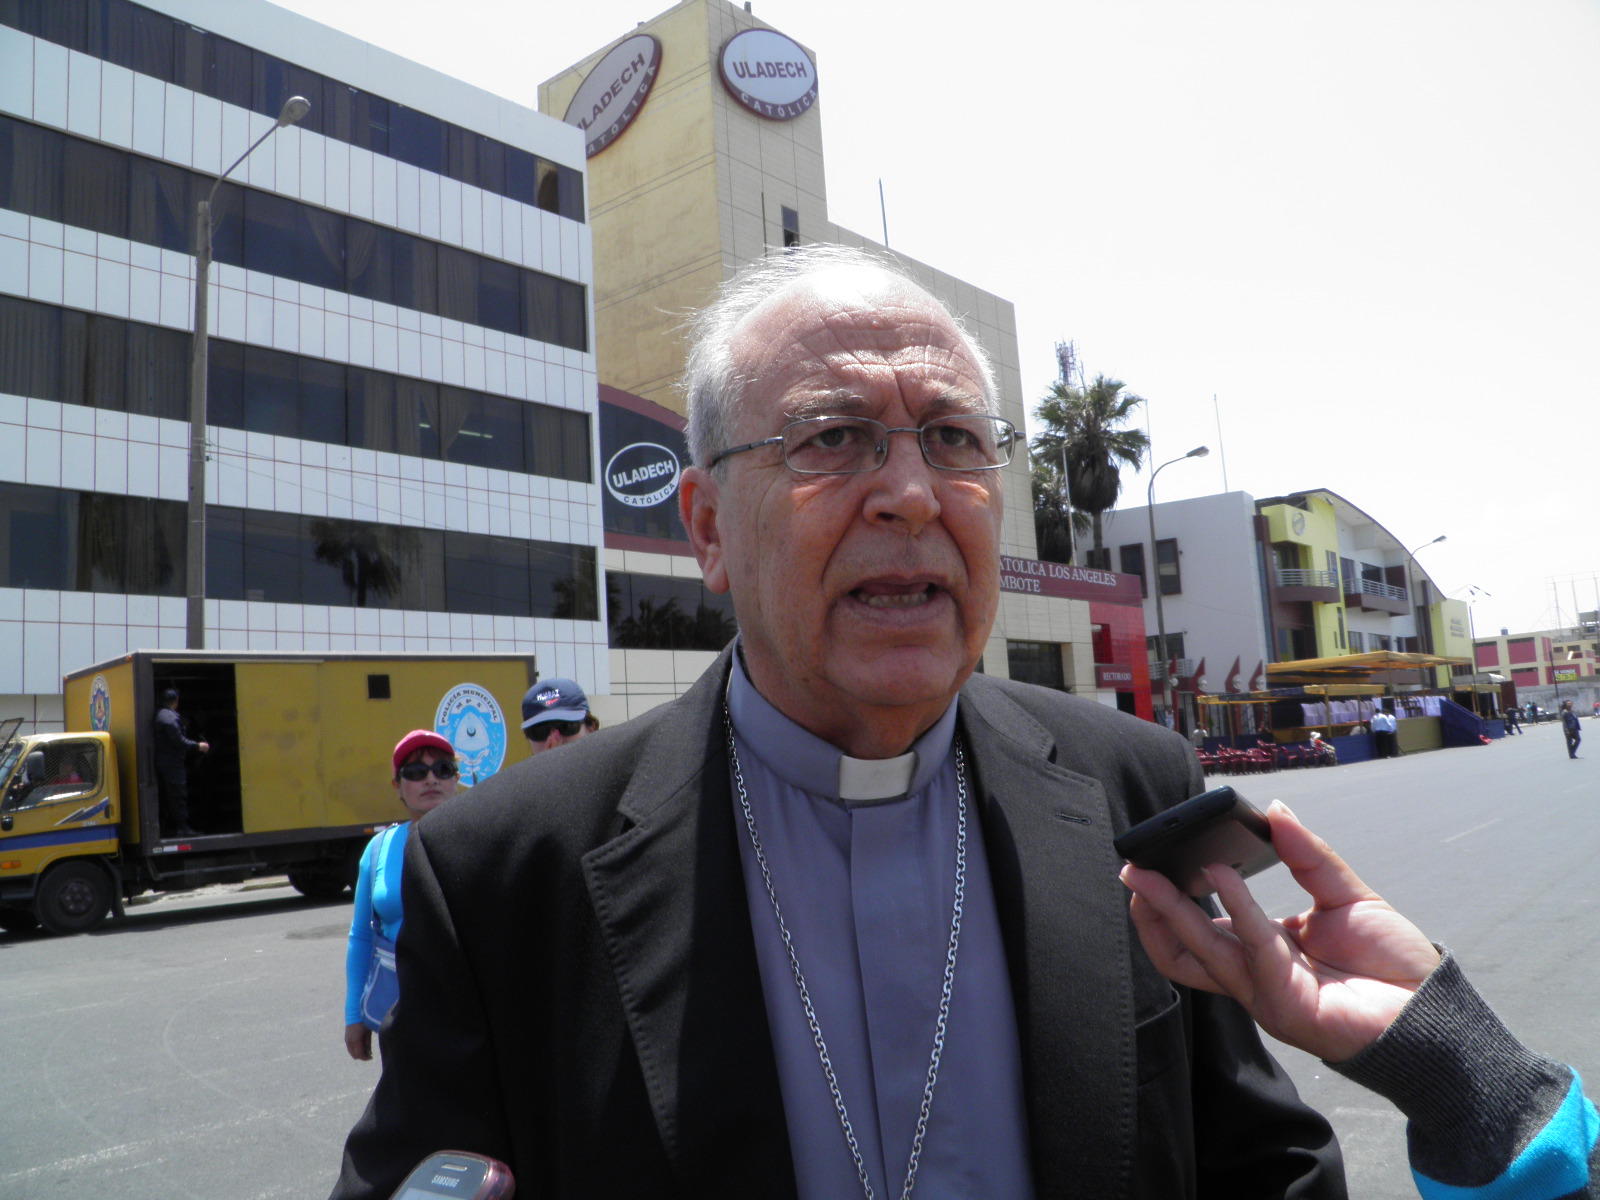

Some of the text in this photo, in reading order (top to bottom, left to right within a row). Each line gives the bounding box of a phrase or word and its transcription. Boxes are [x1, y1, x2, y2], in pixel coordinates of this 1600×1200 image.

[732, 61, 808, 79] ULADECH
[587, 66, 656, 154] ATOLICA
[612, 460, 674, 488] ULADECH
[1000, 575, 1041, 592] MBOTE
[1049, 564, 1070, 579] LOS
[1071, 568, 1117, 587] ANGELES
[1103, 671, 1132, 681] RECTORADO
[462, 689, 498, 721] MUNICIPAL
